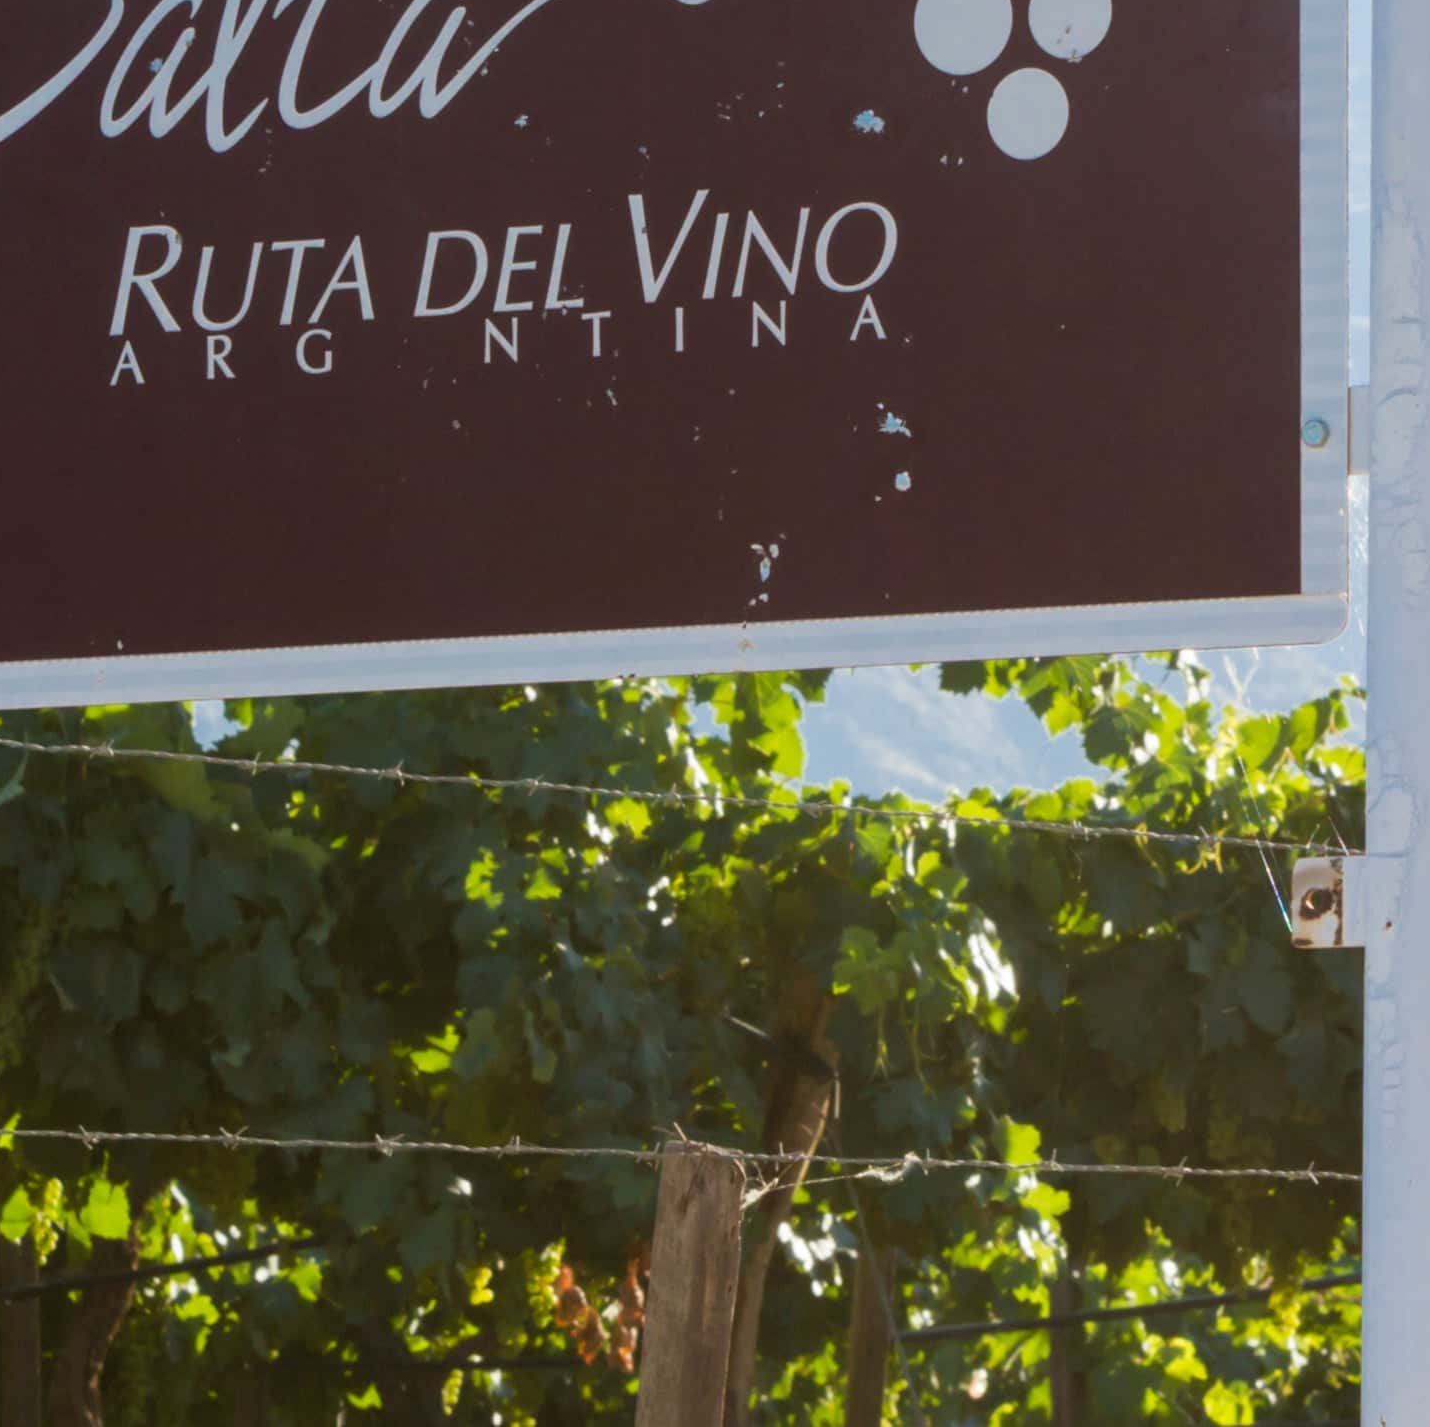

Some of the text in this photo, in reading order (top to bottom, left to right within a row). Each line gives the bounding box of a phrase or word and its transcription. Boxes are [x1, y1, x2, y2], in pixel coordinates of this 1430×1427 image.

[109, 188, 898, 336] RUTA DEL VINO
[110, 295, 887, 386] ARGNTINA
